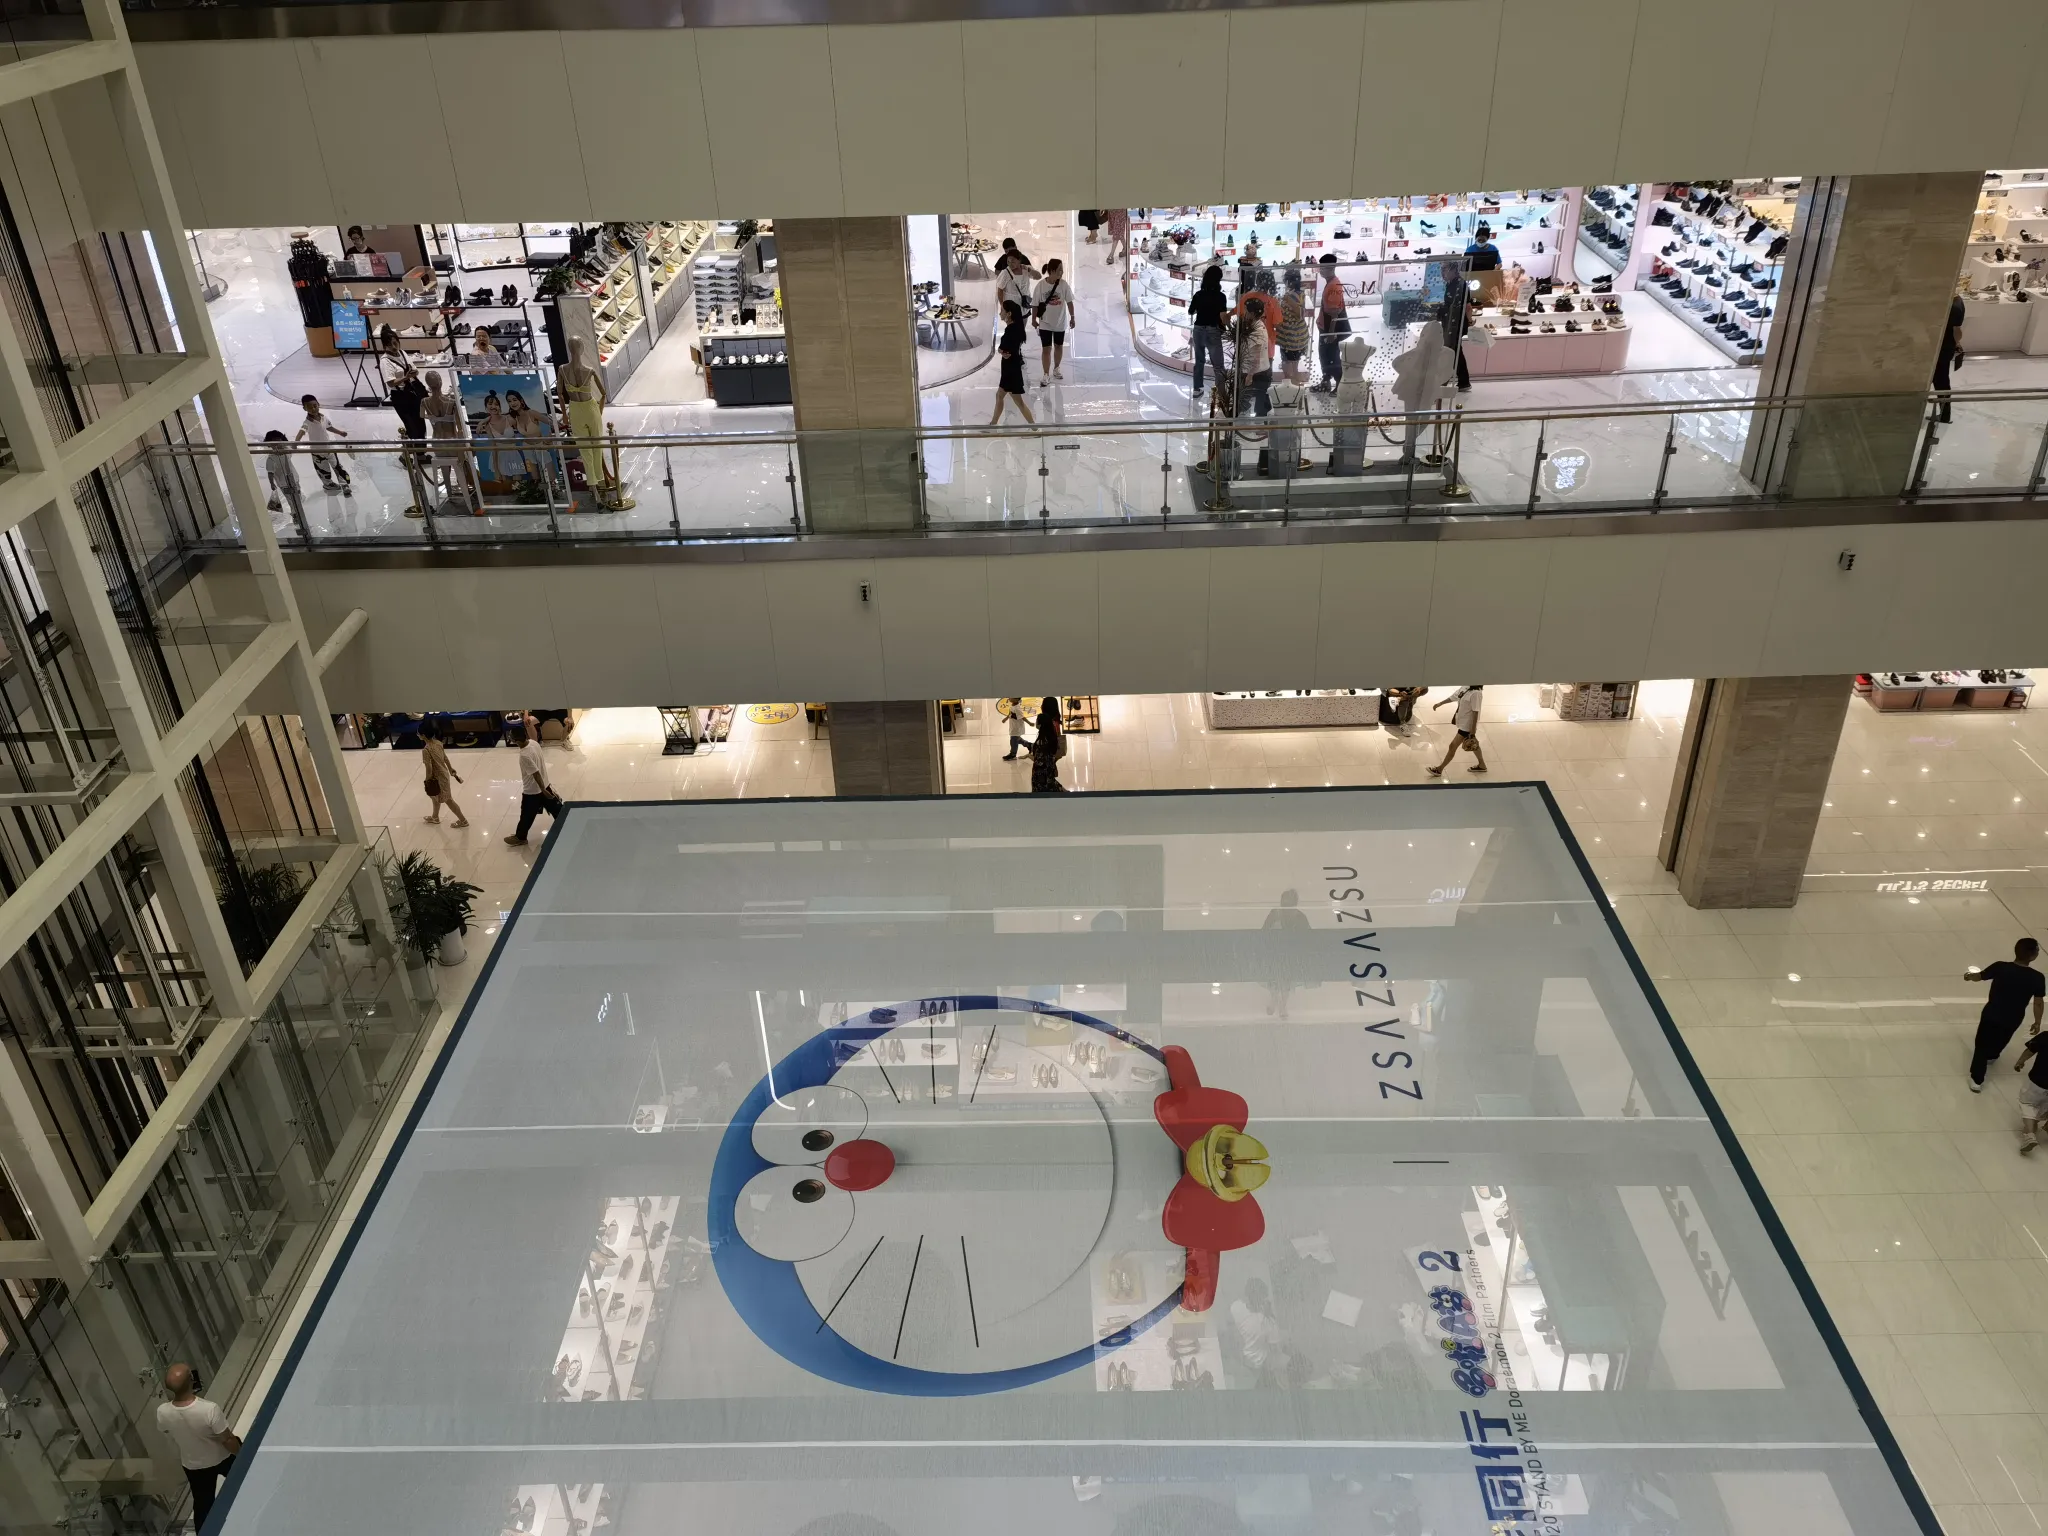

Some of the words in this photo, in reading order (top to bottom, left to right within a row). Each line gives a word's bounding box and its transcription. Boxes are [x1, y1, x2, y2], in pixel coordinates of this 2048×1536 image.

[1418, 1250, 1462, 1272] 2
[1465, 1248, 1491, 1300] Partners
[1481, 1303, 1499, 1329] Film
[1487, 1331, 1501, 1340] 2
[1494, 1343, 1523, 1408] Doraemon
[1511, 1412, 1531, 1433] ME
[1518, 1437, 1539, 1454] BY
[1459, 1409, 1540, 1536] 同行
[1526, 1459, 1554, 1510] STAND
[1542, 1516, 1562, 1536] 20
